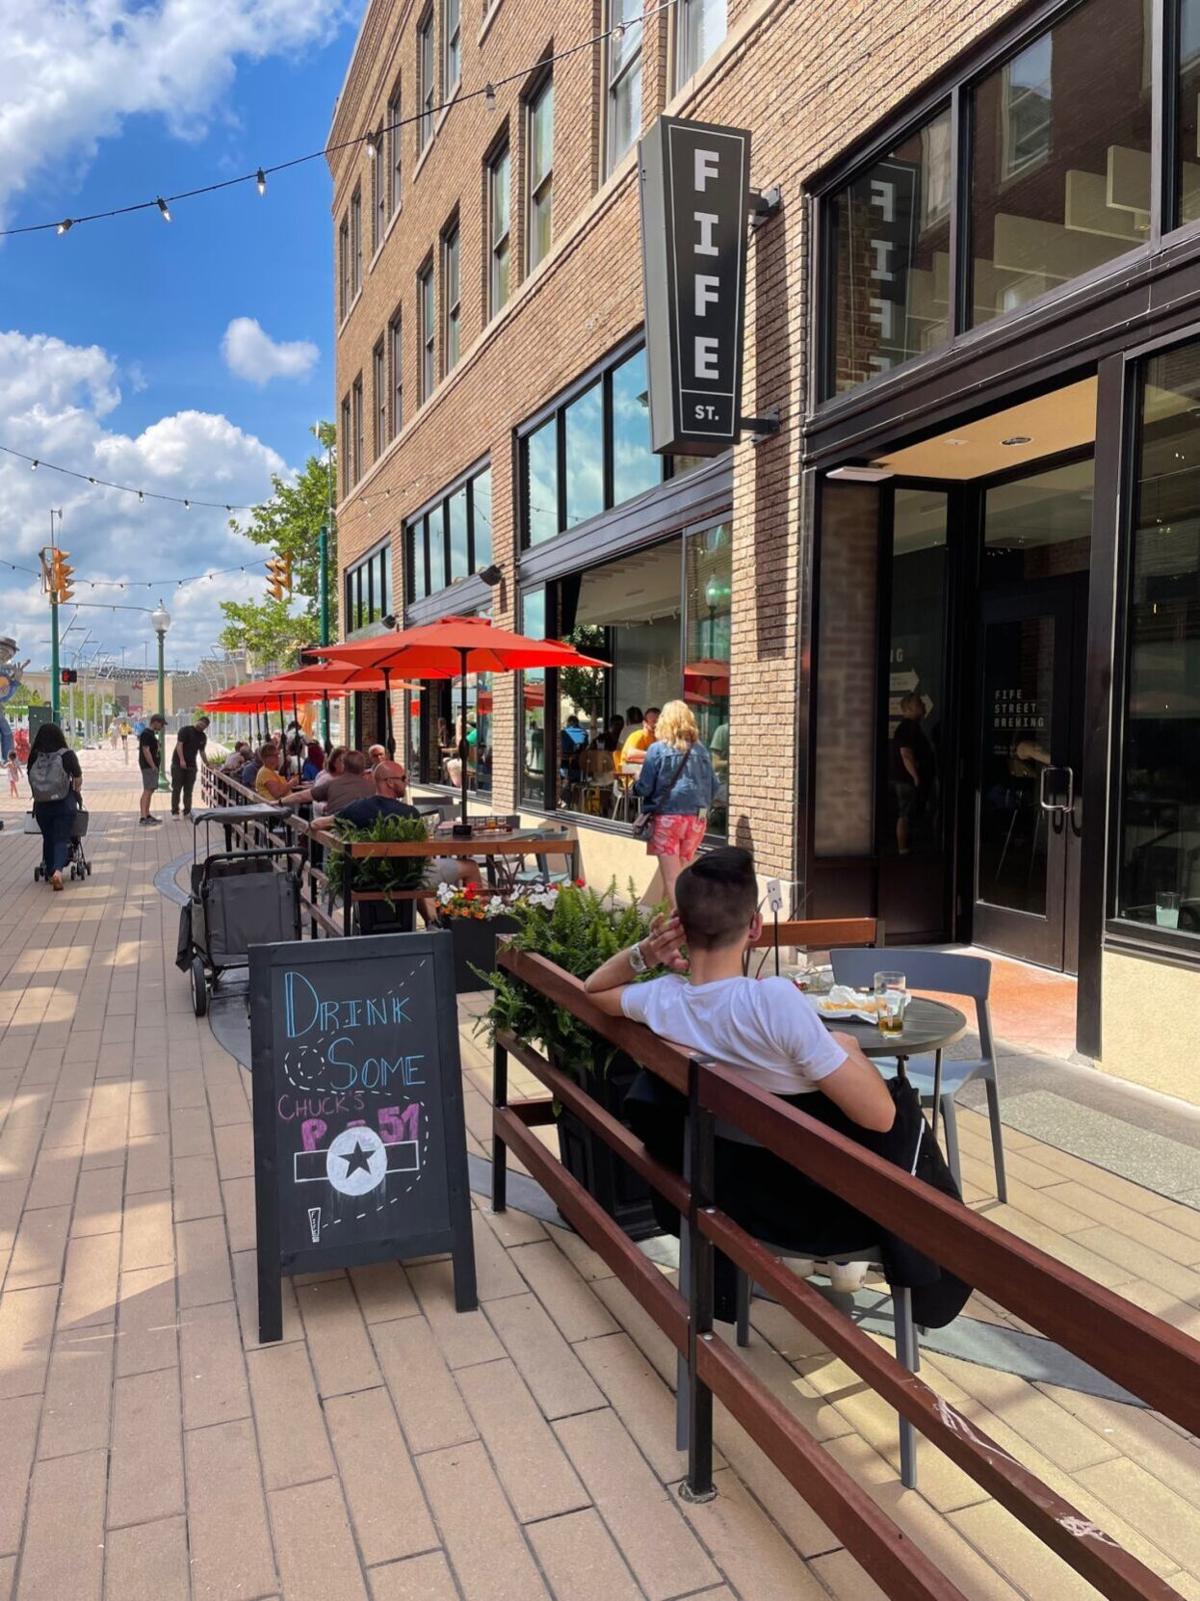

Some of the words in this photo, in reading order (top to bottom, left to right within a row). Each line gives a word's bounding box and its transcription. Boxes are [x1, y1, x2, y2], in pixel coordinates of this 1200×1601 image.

[694, 148, 720, 380] FIFE
[694, 405, 720, 421] ST.
[995, 688, 1023, 700] FIFE
[994, 703, 1037, 714] STREET
[993, 717, 1045, 728] BREWING
[284, 971, 412, 1038] DRINK
[328, 1037, 426, 1090] SOME
